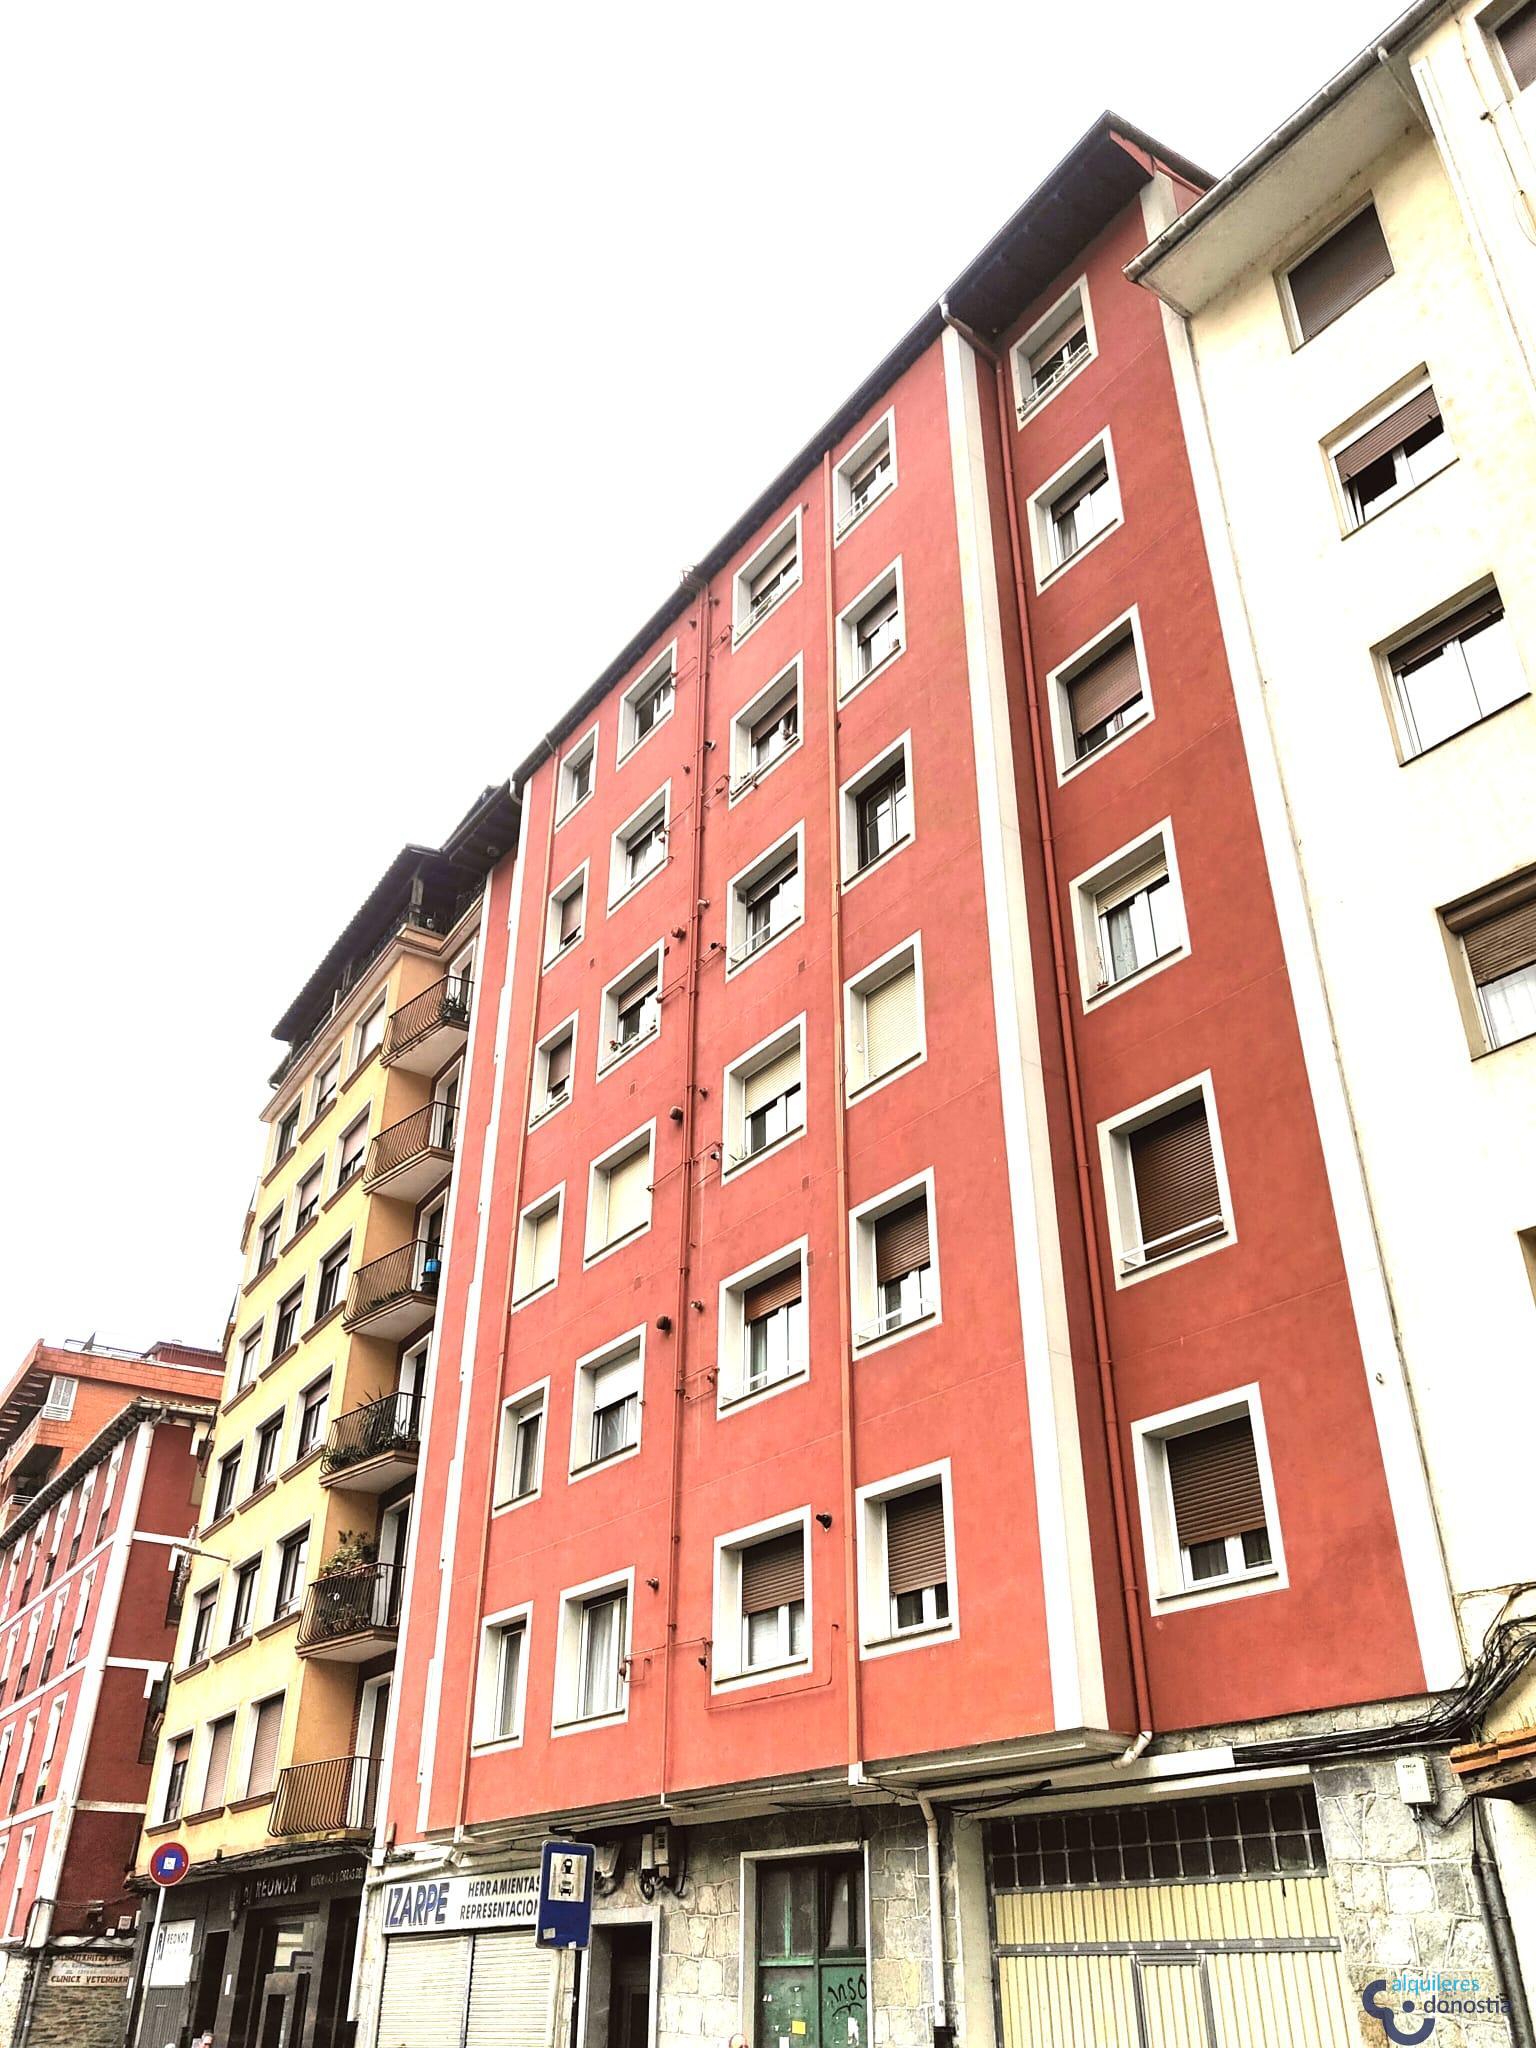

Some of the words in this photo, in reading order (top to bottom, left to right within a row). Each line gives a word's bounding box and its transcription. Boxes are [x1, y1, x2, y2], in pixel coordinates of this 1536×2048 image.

[468, 1875, 540, 1898] HERRAMIENTAS
[385, 1882, 450, 1928] IZARPE
[51, 1975, 81, 1983] CLINICA
